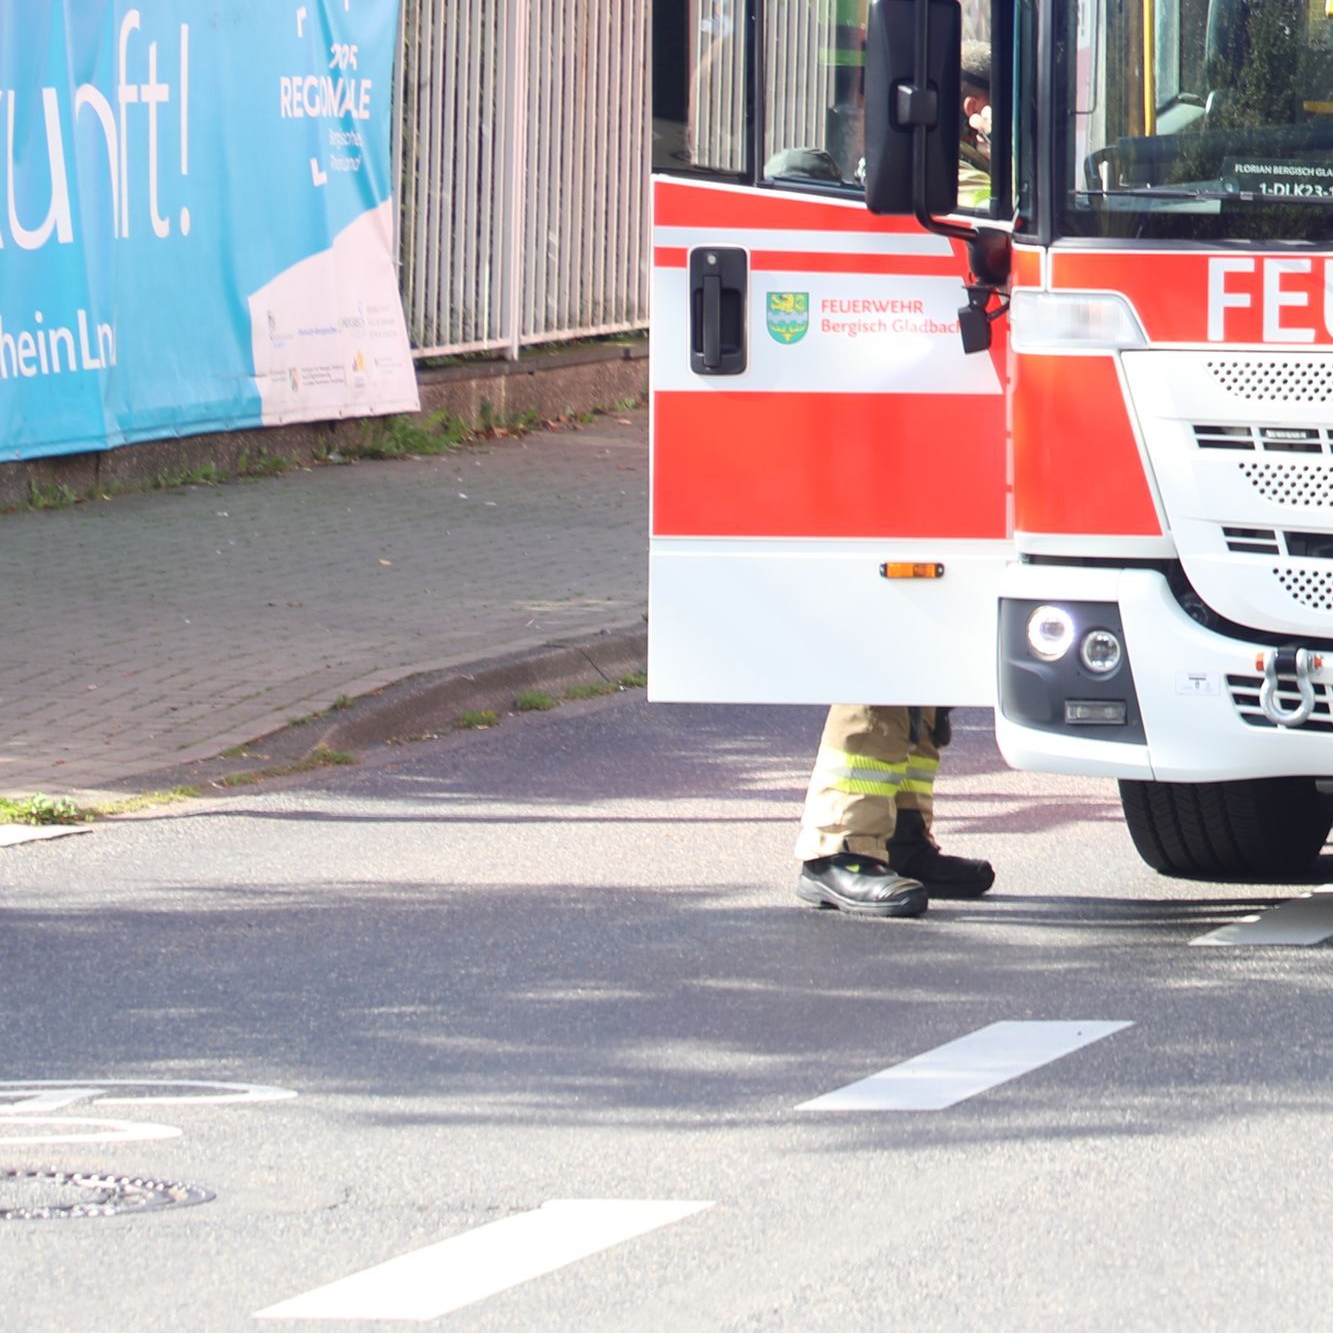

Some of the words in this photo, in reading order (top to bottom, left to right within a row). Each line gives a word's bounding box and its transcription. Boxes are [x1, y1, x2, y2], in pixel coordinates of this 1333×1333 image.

[0, 9, 190, 251] unft!
[1234, 164, 1273, 174] FLORIAN
[1273, 165, 1315, 176] BERGISCH
[821, 299, 924, 314] FEUERWEHR
[821, 319, 887, 337] Bergisch
